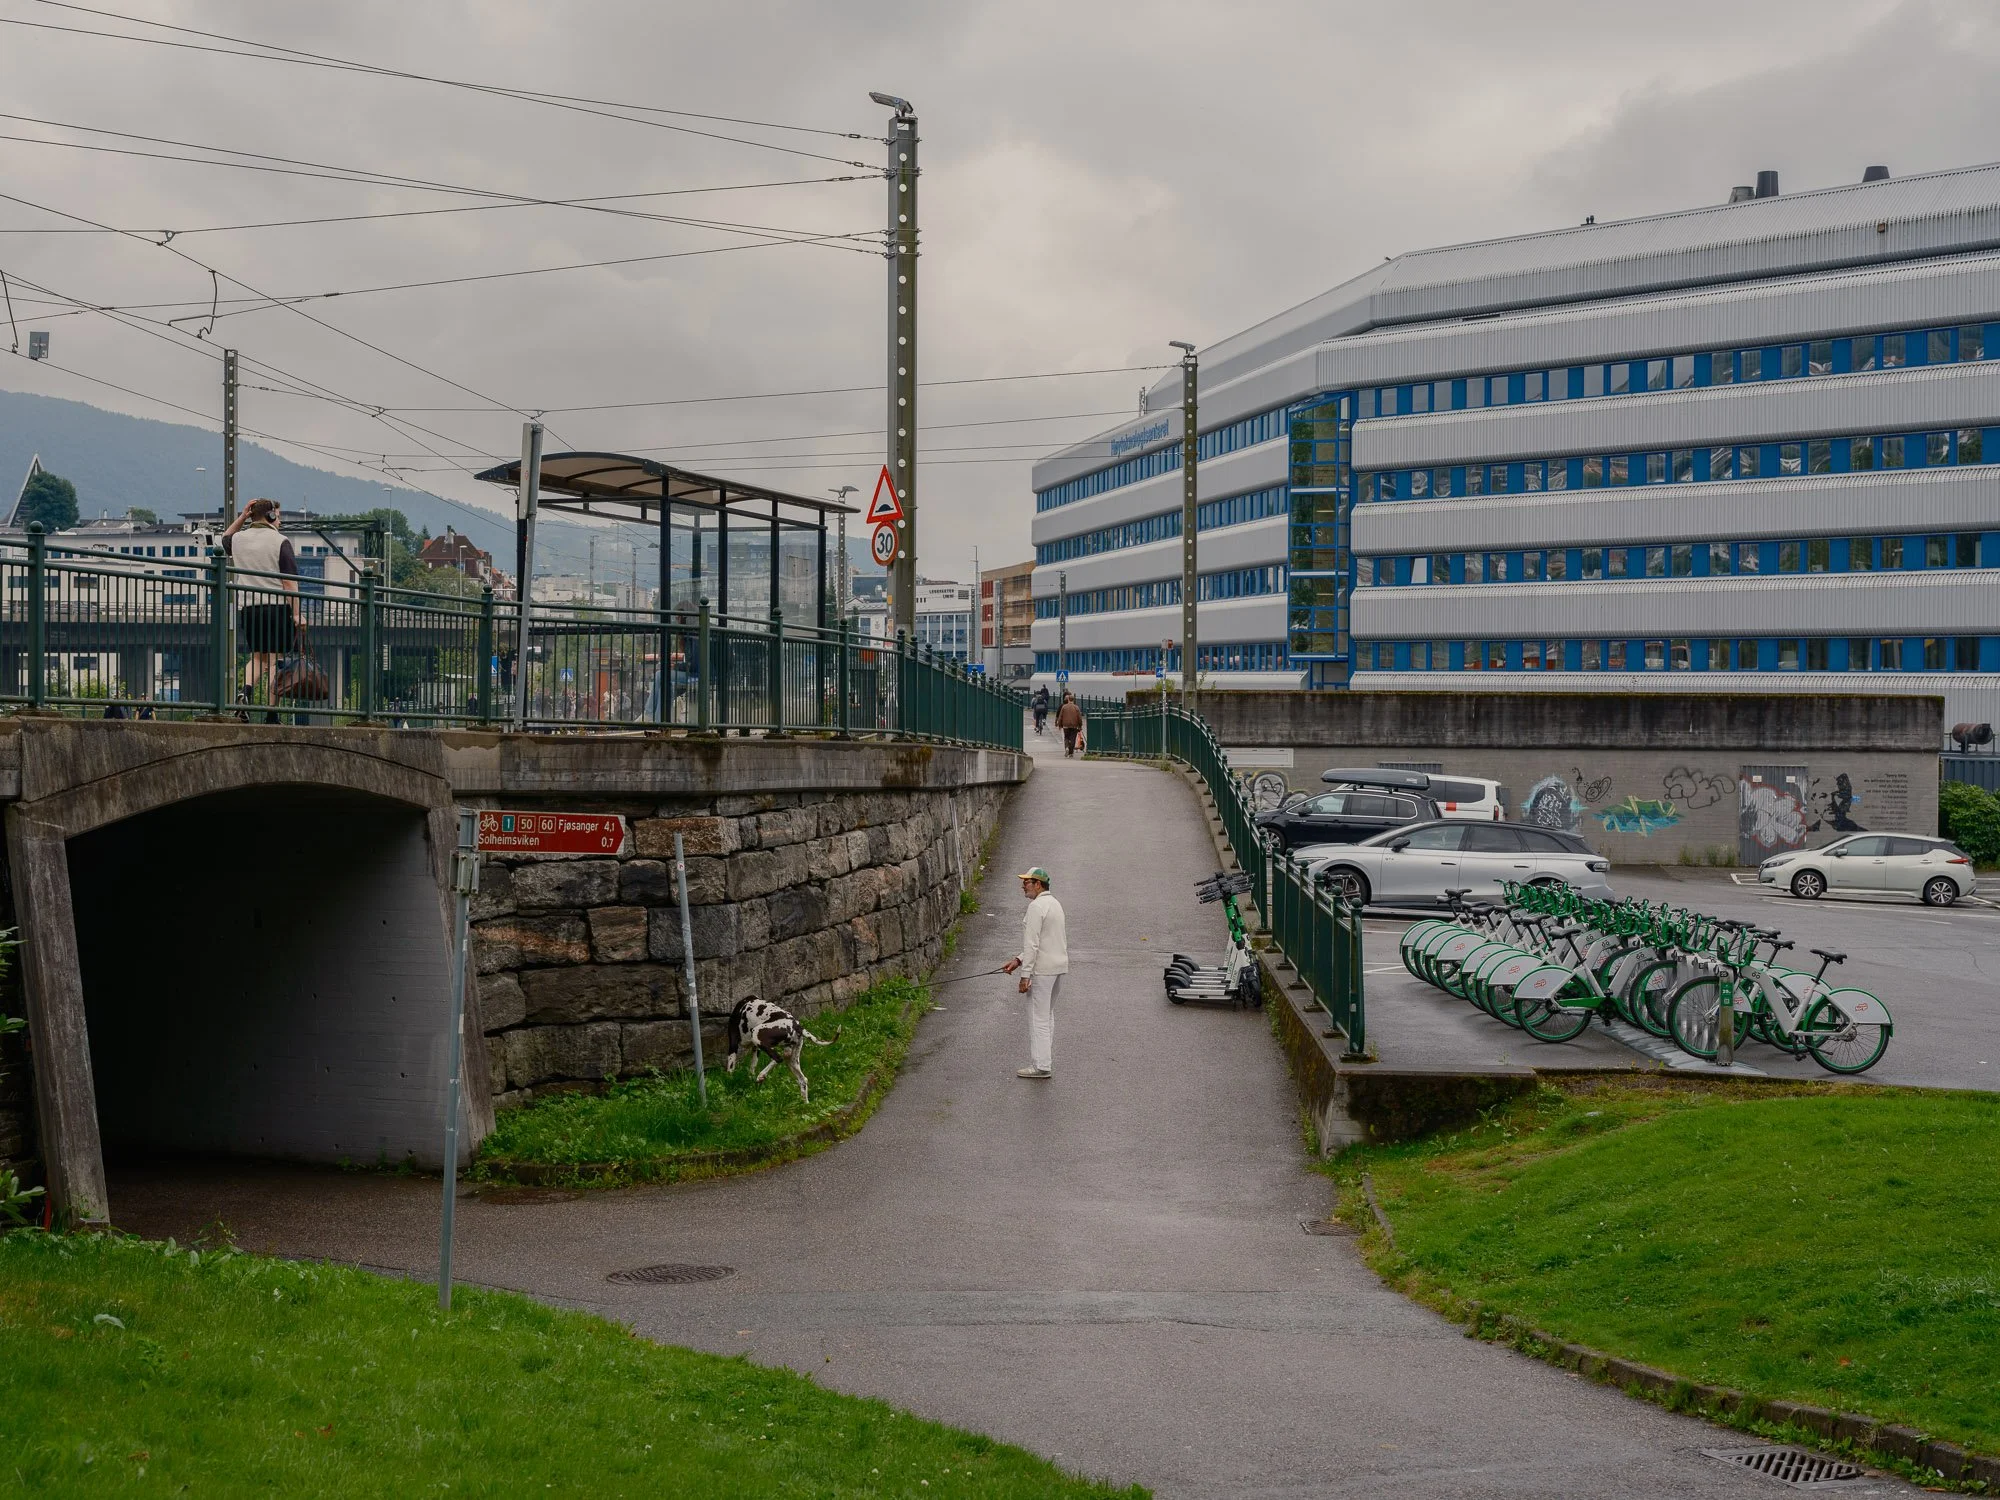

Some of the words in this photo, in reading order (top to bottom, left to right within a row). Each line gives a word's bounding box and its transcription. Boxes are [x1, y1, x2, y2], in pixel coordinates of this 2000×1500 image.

[877, 533, 893, 554] 30
[521, 819, 532, 830] 50
[541, 820, 553, 830] 60
[558, 820, 599, 833] Fjøsanger
[604, 821, 615, 833] 4,1
[478, 833, 540, 846] Solheimsviken
[601, 837, 614, 848] 0,7
